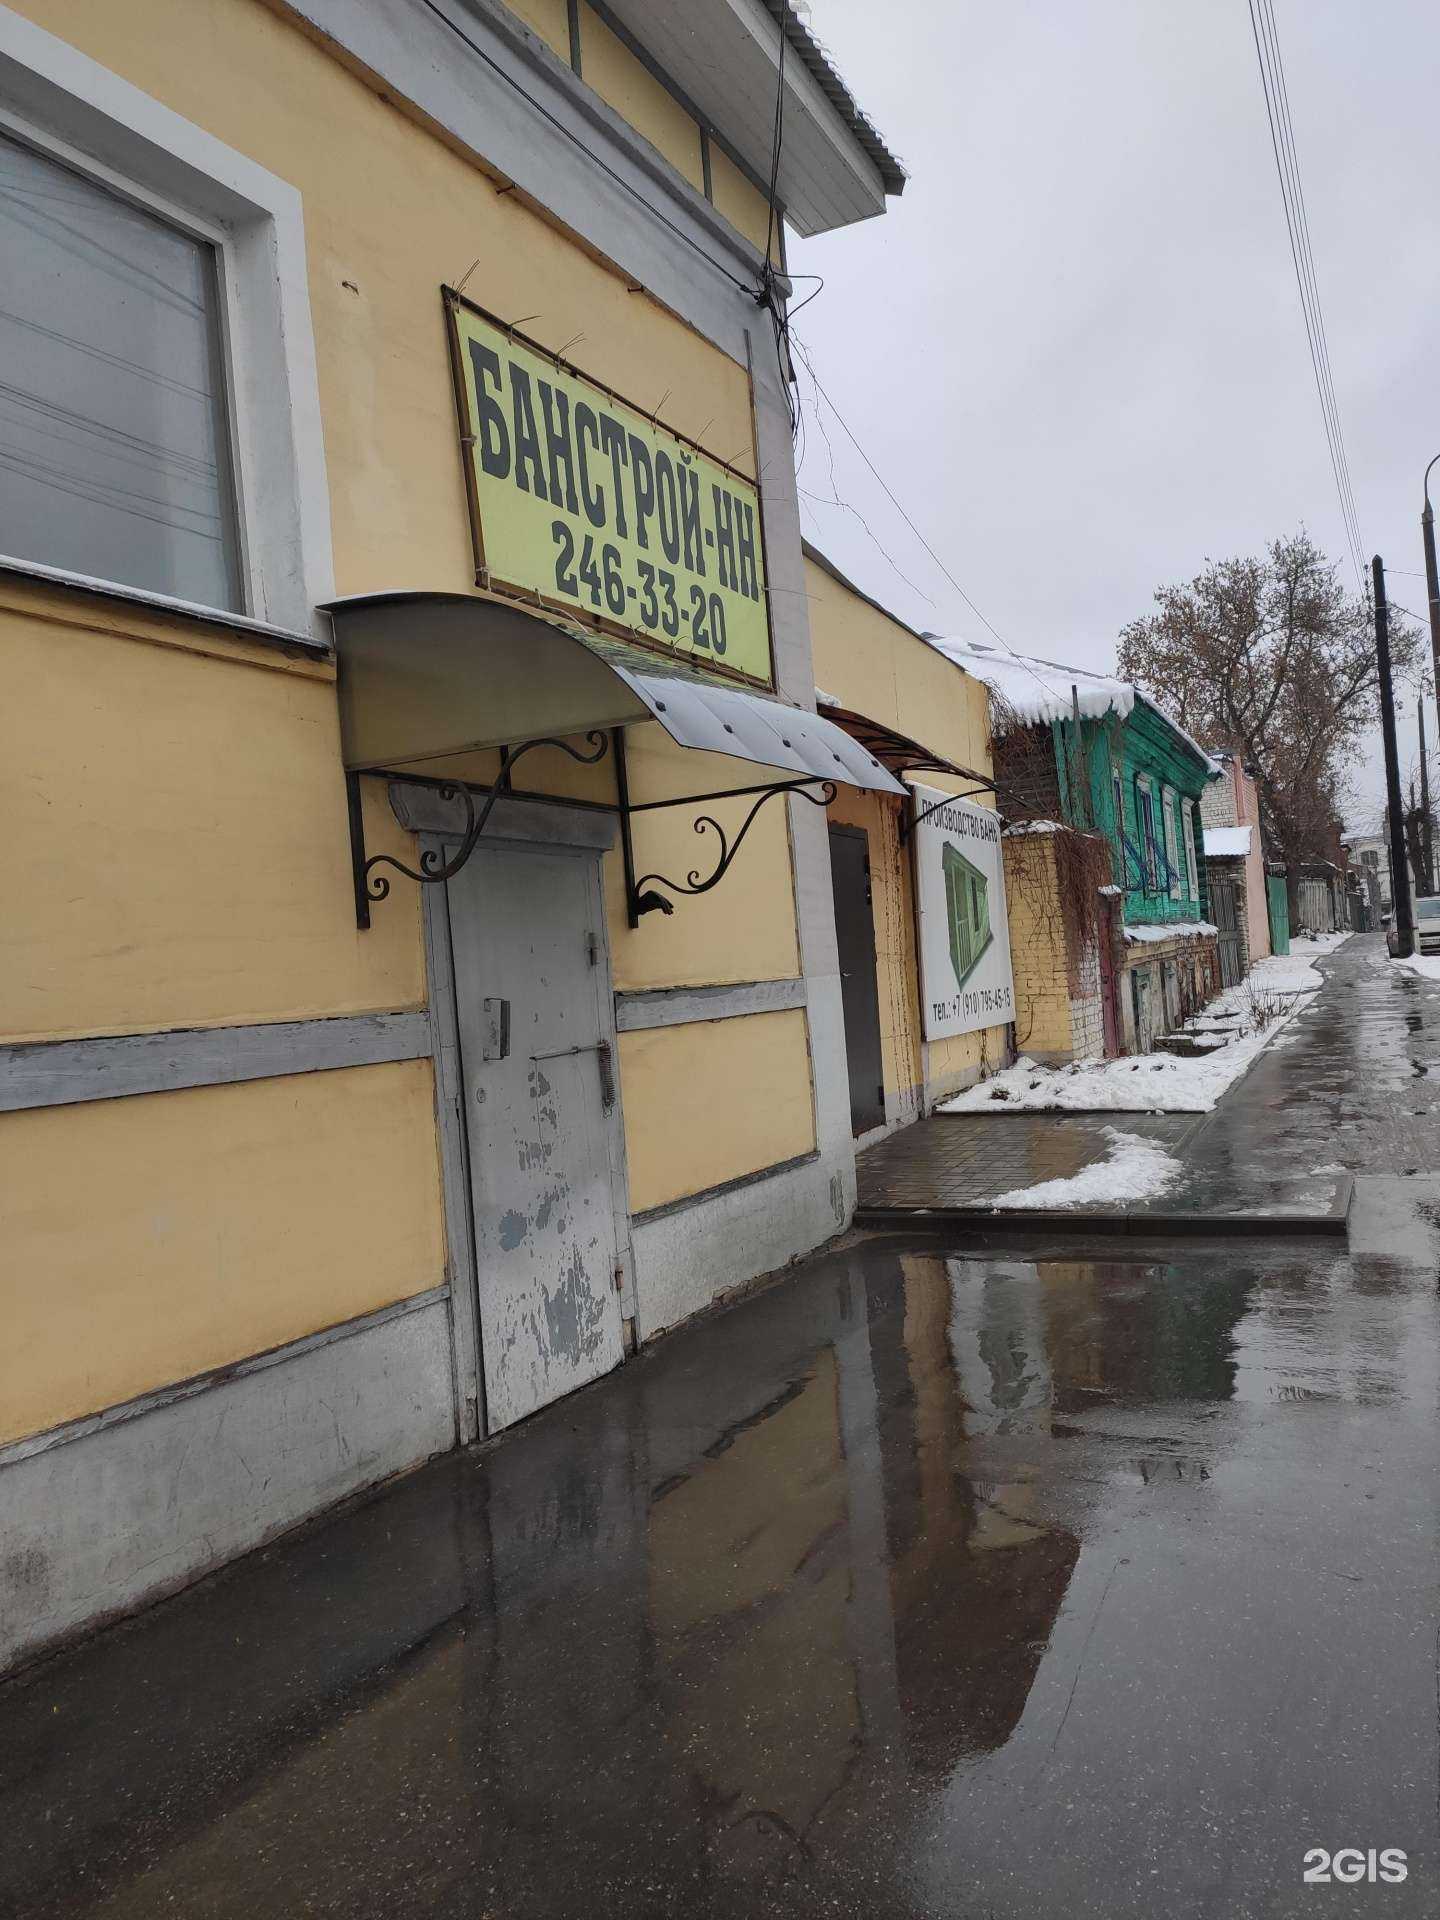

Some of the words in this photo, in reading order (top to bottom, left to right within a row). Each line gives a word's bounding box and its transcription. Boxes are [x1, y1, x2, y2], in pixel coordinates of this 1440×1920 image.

[469, 338, 758, 602] БАНСТРОЙ-НН
[552, 520, 727, 655] 246-33-20
[922, 799, 979, 840] ПРОИЗВОДСТВО
[980, 818, 998, 842] БАНЬ
[952, 994, 961, 1017] +7
[962, 990, 980, 1022] (910)
[980, 987, 1011, 1012] 795-45-15
